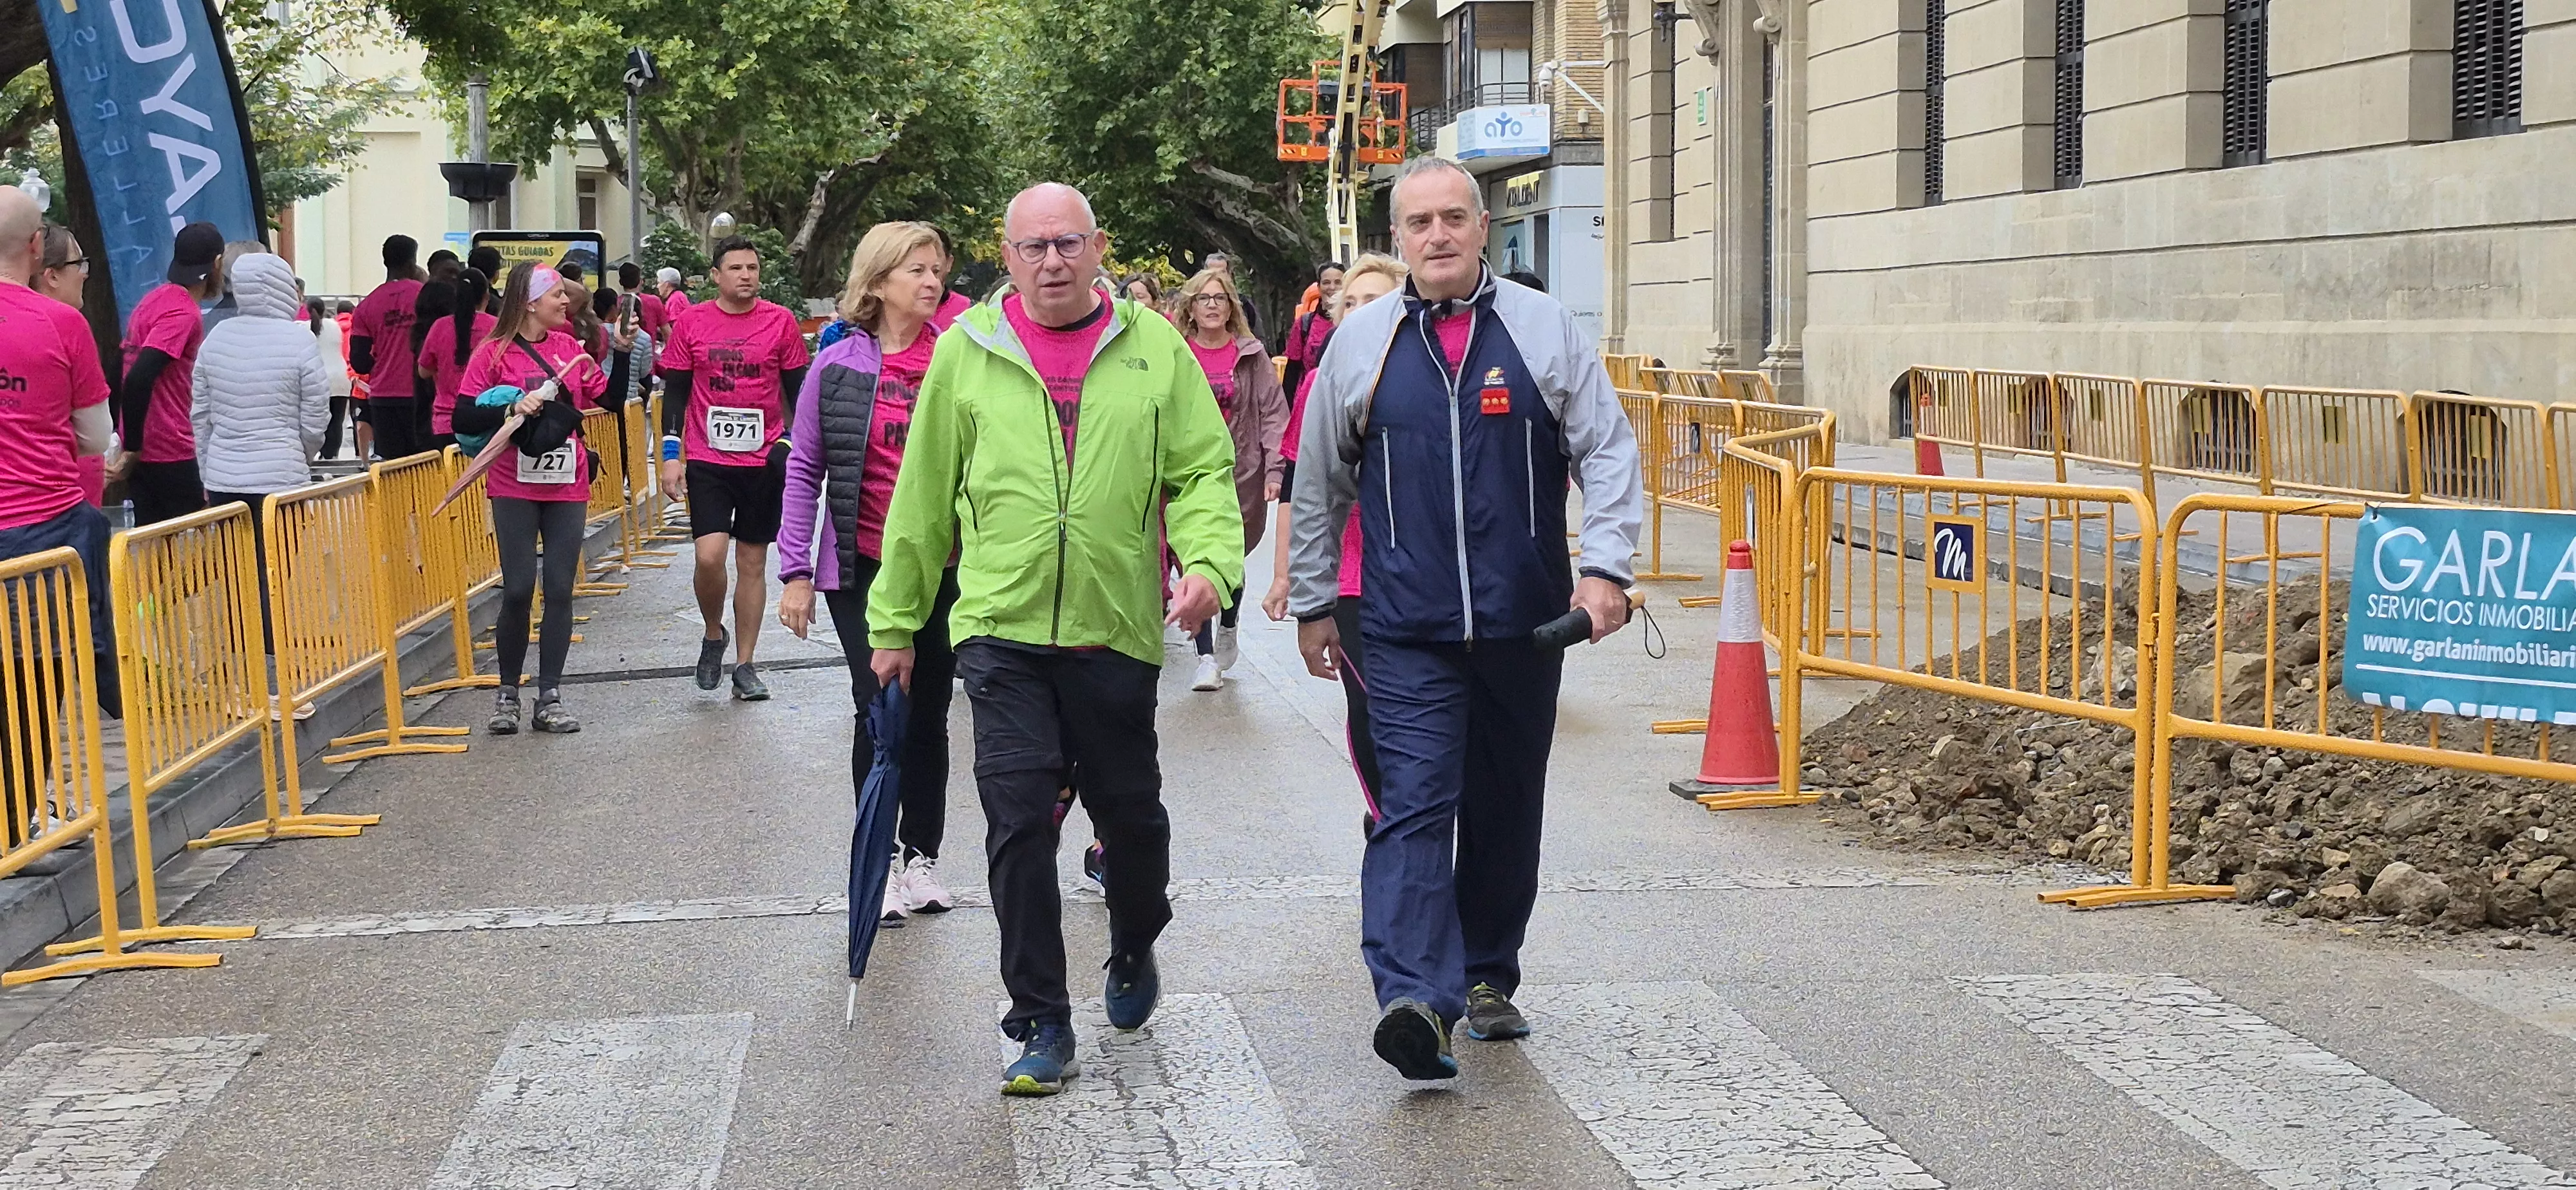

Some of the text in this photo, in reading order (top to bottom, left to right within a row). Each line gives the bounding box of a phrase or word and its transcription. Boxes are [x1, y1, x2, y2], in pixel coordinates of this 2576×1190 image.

[713, 422, 757, 439] 1971
[2373, 527, 2576, 600] GARLA
[2367, 594, 2474, 625] SERVICIOS
